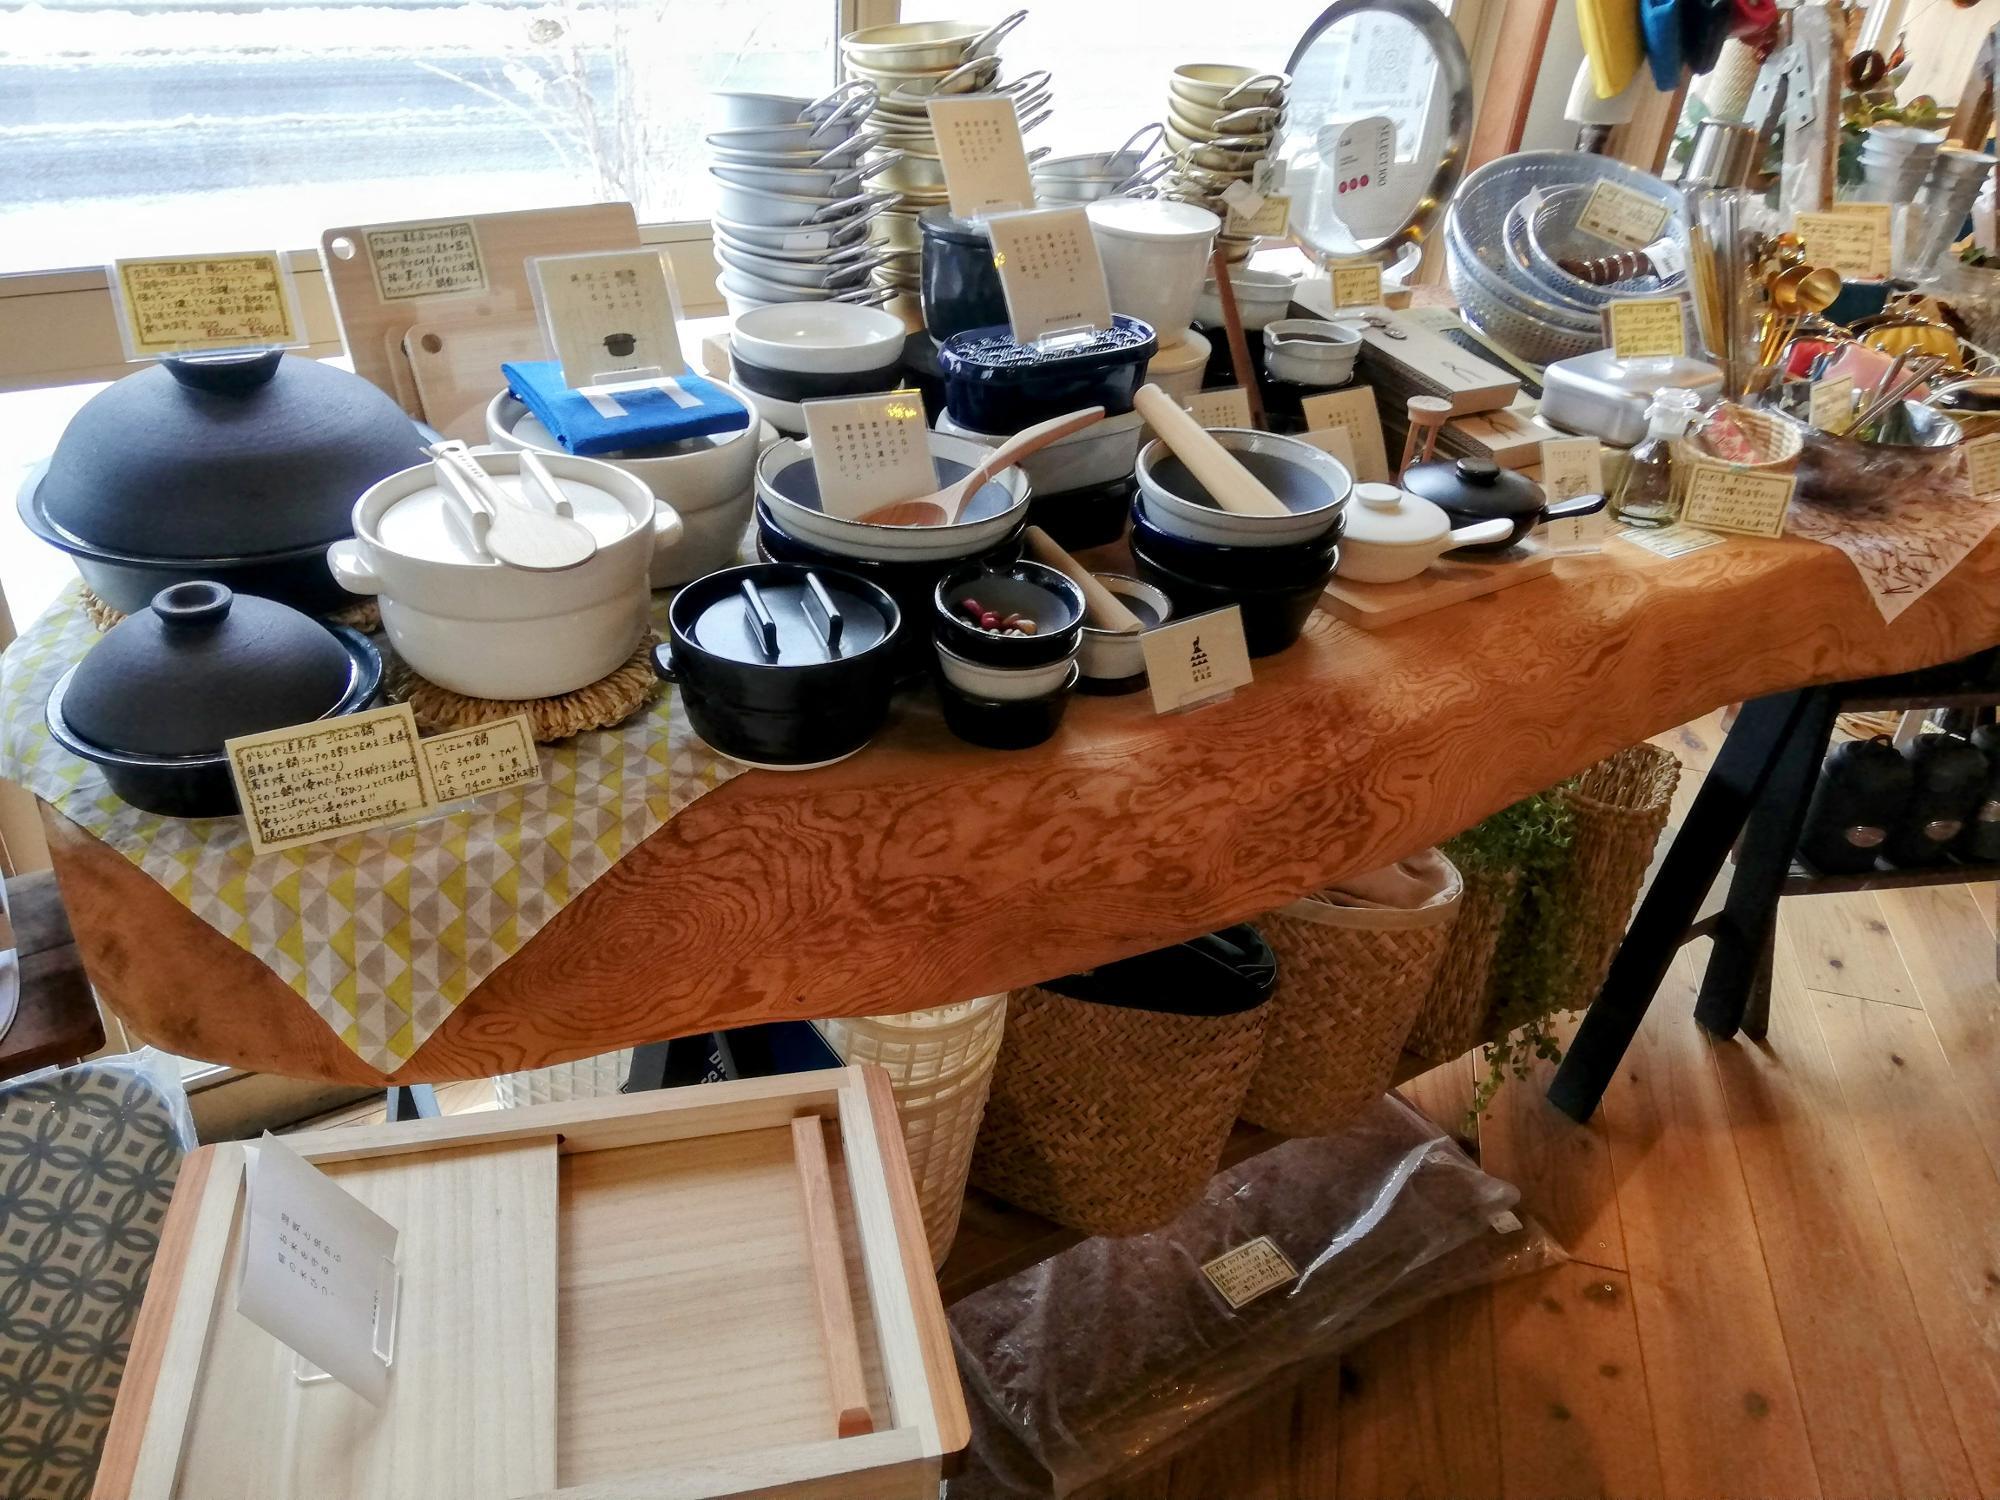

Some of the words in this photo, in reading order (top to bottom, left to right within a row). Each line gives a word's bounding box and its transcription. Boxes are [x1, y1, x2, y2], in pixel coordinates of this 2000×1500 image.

[244, 736, 320, 763] かもしか道具店
